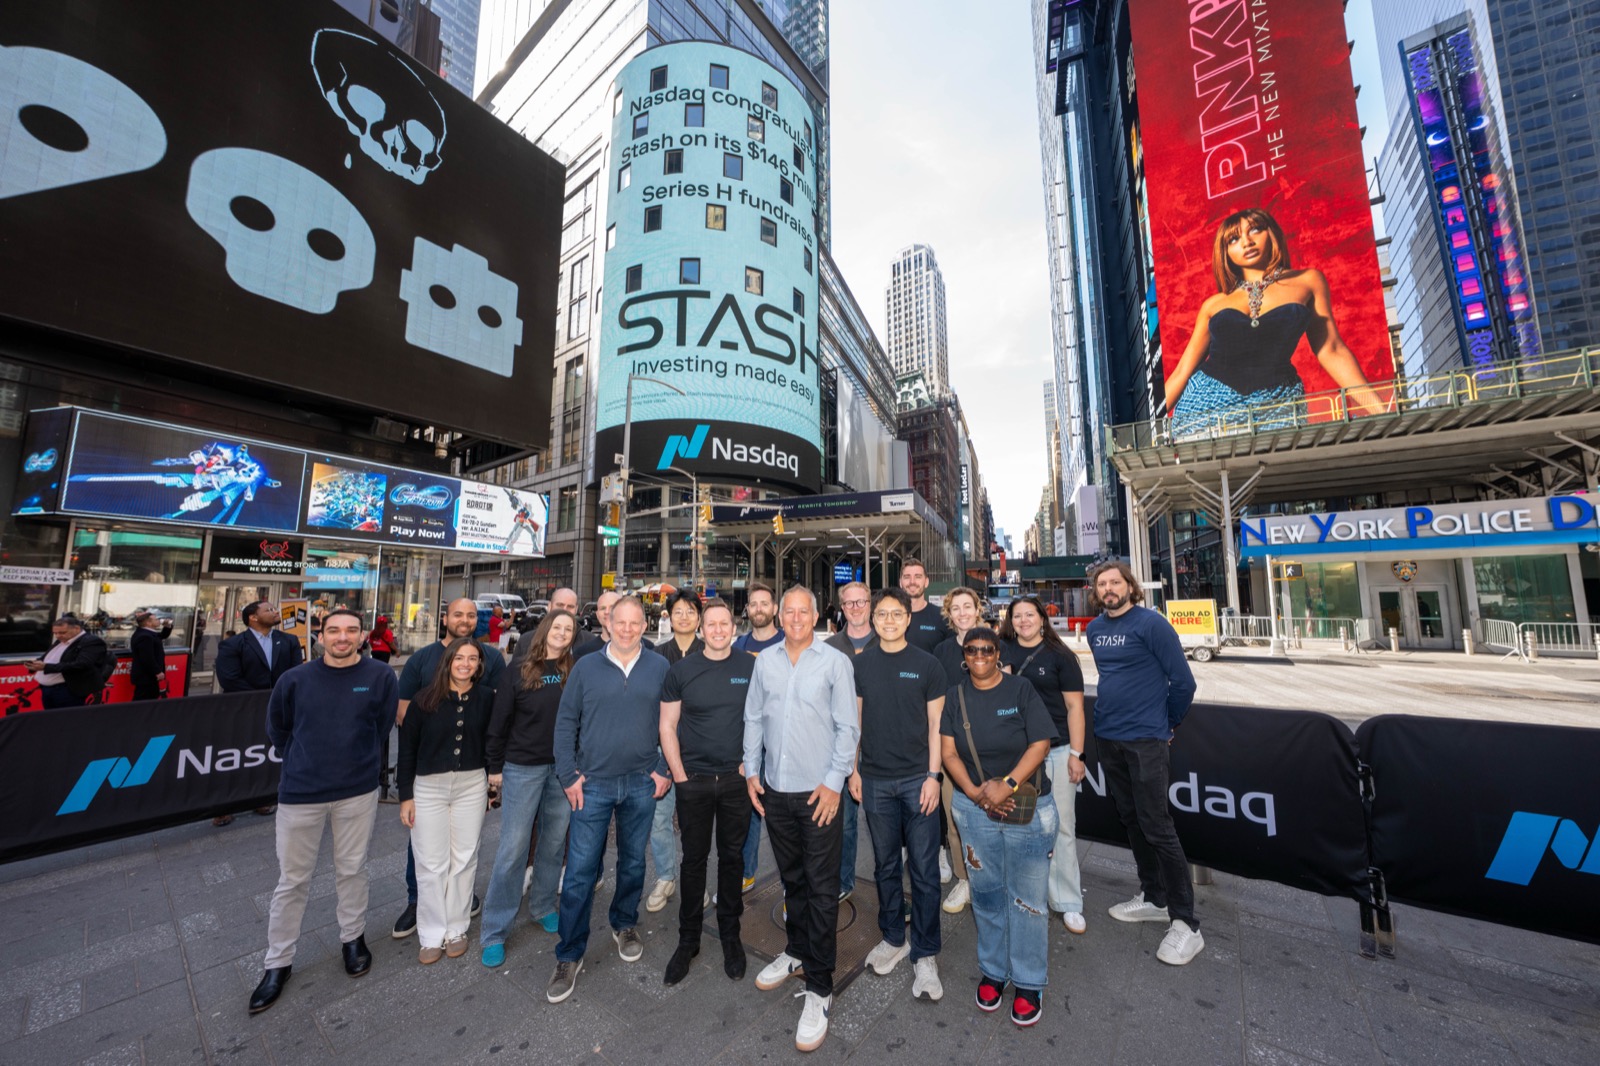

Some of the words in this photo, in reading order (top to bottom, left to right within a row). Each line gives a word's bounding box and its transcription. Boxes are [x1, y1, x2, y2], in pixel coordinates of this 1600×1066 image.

[630, 86, 706, 116] Nasdaq
[1260, 71, 1280, 122] NEW
[621, 133, 673, 164] Stash
[680, 133, 707, 147] on
[714, 133, 741, 153] its
[747, 141, 789, 176] $146
[1267, 129, 1287, 176] THE
[642, 180, 709, 203] Series
[716, 183, 732, 201] H
[738, 189, 813, 248] fundraise
[632, 355, 728, 378] Investing
[735, 362, 787, 388] made
[790, 378, 815, 406] easy
[711, 437, 799, 478] Nasdaq
[960, 466, 968, 489] Locker
[390, 525, 416, 538] Play
[418, 528, 446, 540] Now!
[1240, 518, 1305, 546] NEW
[1310, 513, 1397, 543] YORK
[1407, 507, 1534, 538] POLICE
[460, 540, 485, 549] Available
[219, 557, 258, 566] TAMASHII
[259, 560, 292, 568] NATIONS
[294, 561, 319, 569] STORE
[1171, 617, 1202, 625] HERE
[1095, 634, 1126, 647] STASH
[899, 671, 920, 679] STASH
[1038, 667, 1046, 675] S
[996, 706, 1019, 717] STASH
